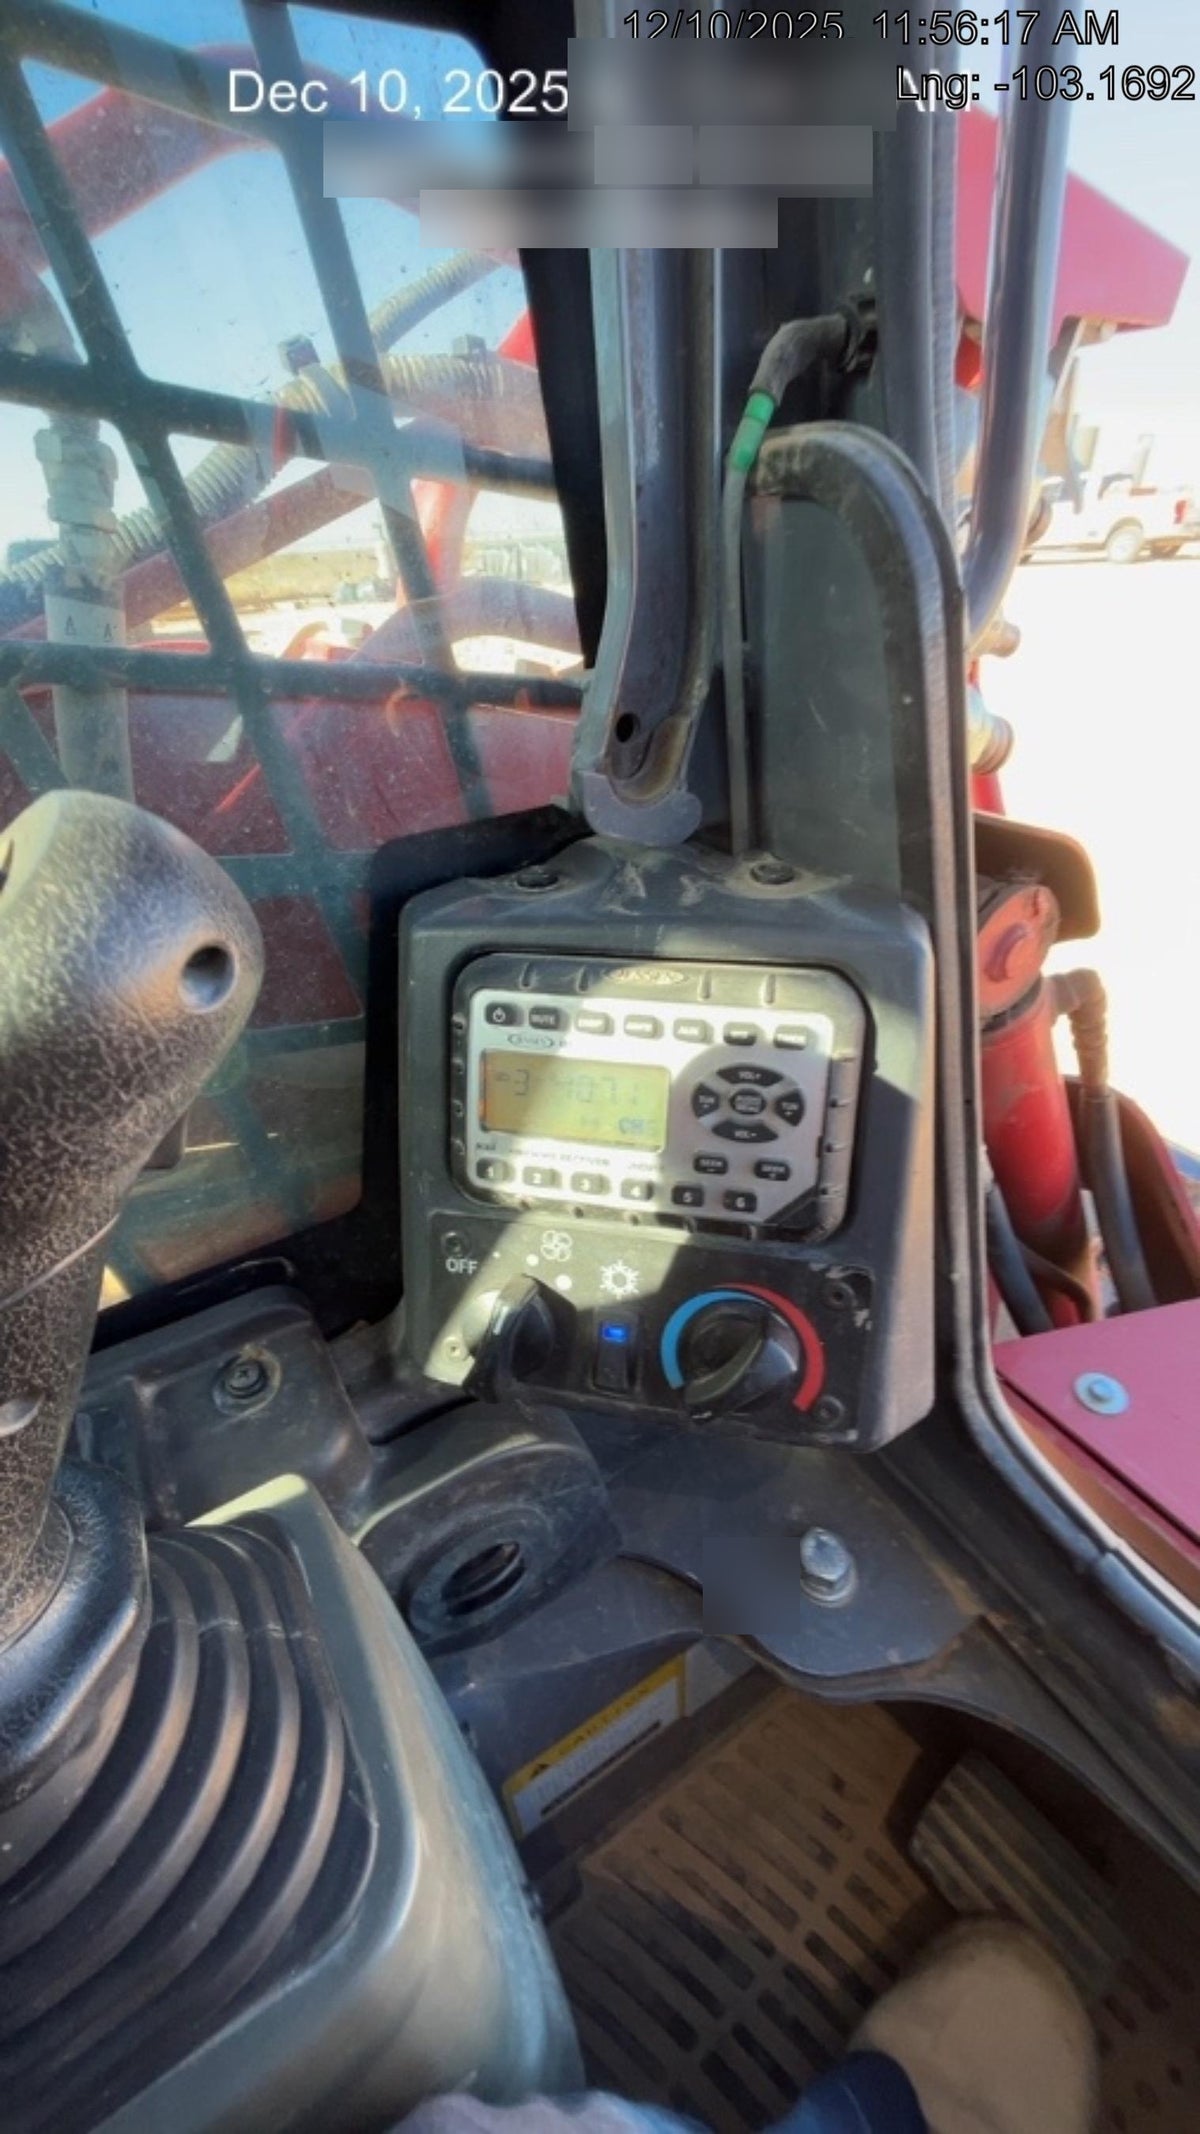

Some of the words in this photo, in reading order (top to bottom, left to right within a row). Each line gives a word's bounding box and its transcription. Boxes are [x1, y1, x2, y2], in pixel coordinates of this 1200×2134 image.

[486, 1167, 494, 1179] 1
[533, 1173, 542, 1185] 2
[581, 1179, 591, 1192] 3
[630, 1185, 642, 1198] 4
[682, 1190, 693, 1204] 5
[736, 1196, 746, 1209] 6
[445, 1258, 478, 1275] OFF
